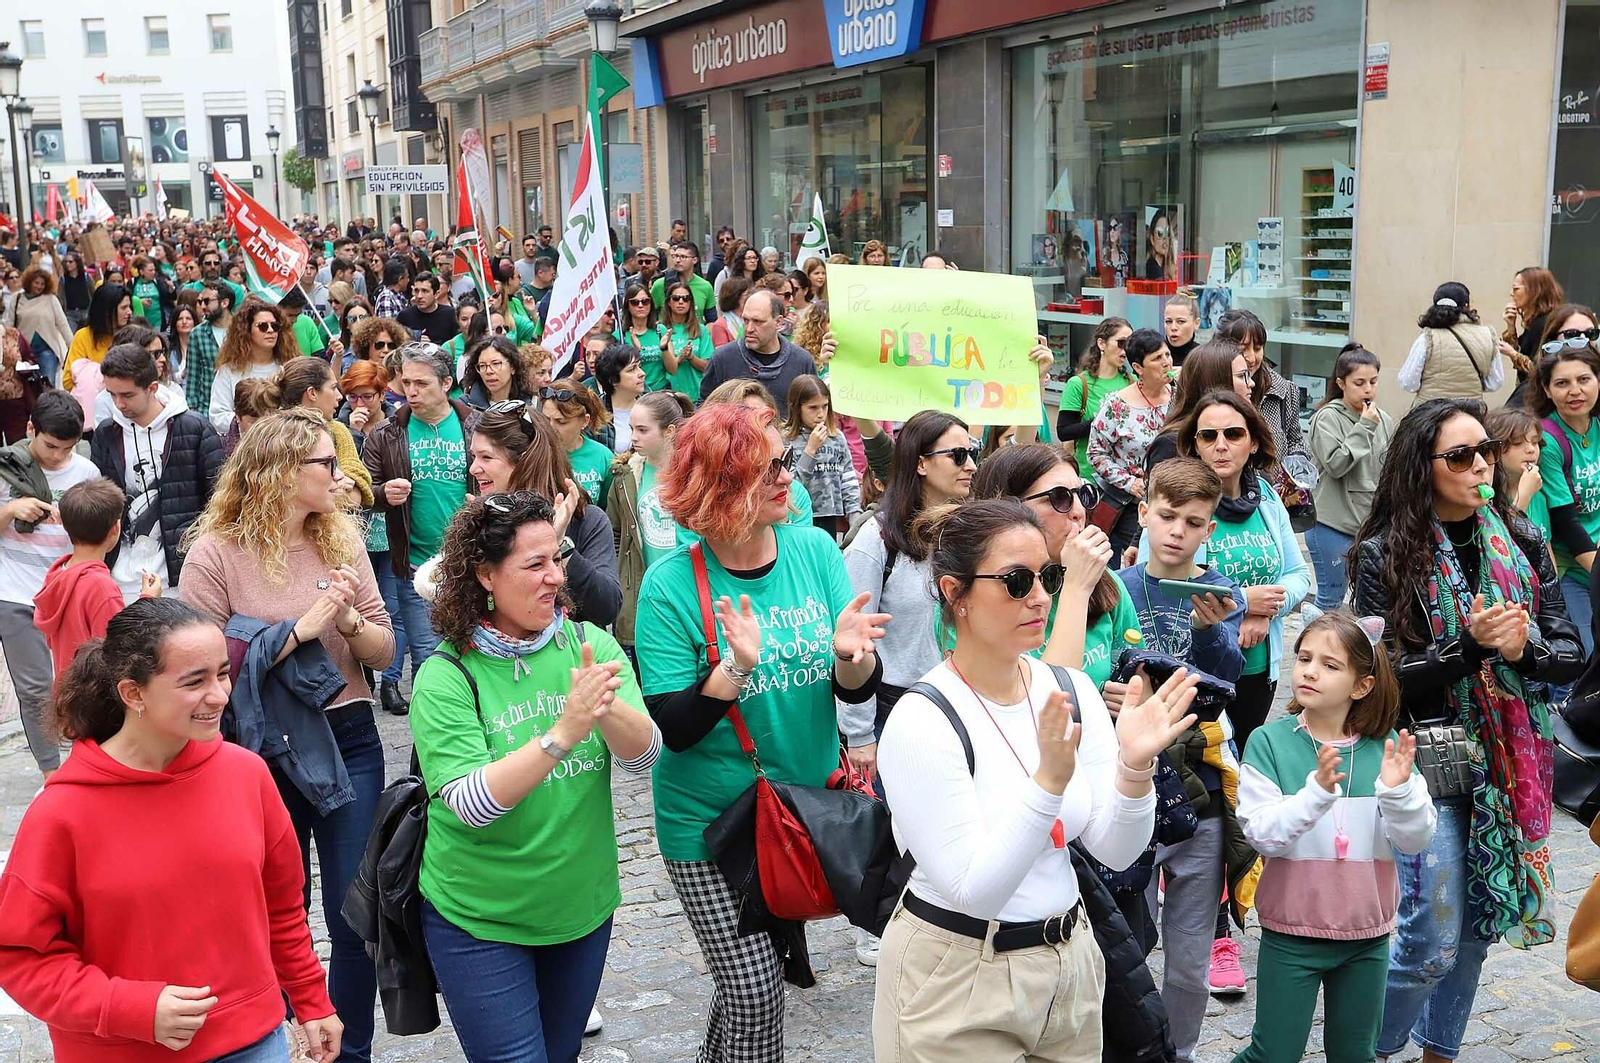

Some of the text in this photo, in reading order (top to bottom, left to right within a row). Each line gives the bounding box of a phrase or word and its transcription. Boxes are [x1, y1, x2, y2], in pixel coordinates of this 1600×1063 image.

[838, 10, 897, 56] urbano
[1100, 39, 1111, 57] de
[1113, 39, 1126, 54] su
[1128, 32, 1154, 52] vista
[1157, 31, 1175, 52] por
[1223, 5, 1315, 40] optometristas
[692, 16, 787, 84] óptica urbano
[370, 182, 445, 192] SIN PRIVILEGIOS
[847, 283, 874, 313] Por
[888, 301, 932, 314] una
[947, 378, 1034, 410] TODOS
[484, 700, 547, 735] ESCUELA
